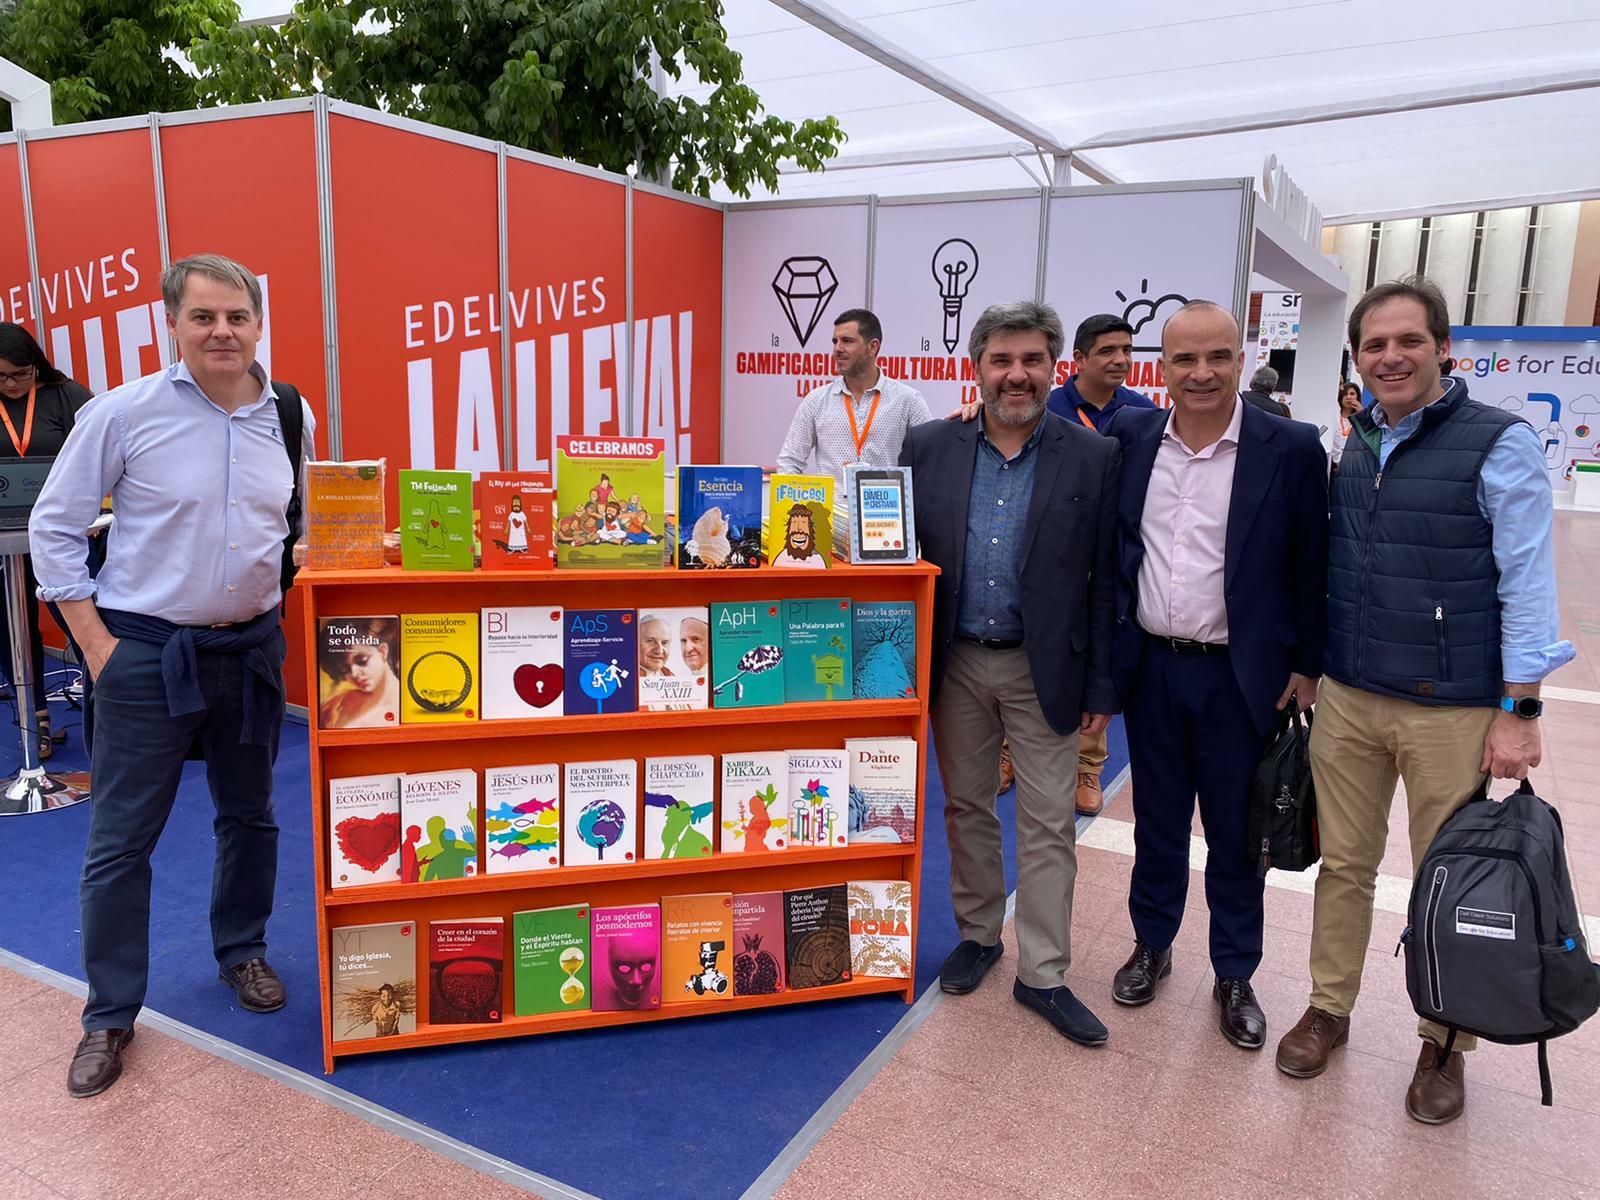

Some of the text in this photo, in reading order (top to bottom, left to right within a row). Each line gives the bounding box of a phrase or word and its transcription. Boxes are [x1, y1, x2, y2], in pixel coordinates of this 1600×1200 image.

[405, 276, 606, 349] EDELVIVES
[772, 334, 779, 346] la
[921, 337, 930, 351] la
[877, 356, 957, 380] CULTURA
[1450, 352, 1510, 378] ogle
[1517, 355, 1554, 373] for
[570, 440, 654, 455] CELEBRAMOS
[698, 480, 743, 492] Esencia
[789, 602, 811, 620] PT
[405, 618, 466, 626] Consumidores
[488, 612, 507, 633] BI
[719, 606, 756, 629] ApH
[328, 625, 356, 635] Todo
[405, 626, 456, 634] consumidos
[570, 615, 608, 635] ApS
[344, 636, 380, 645] olvida
[642, 679, 658, 688] San
[661, 688, 692, 698] XXIII
[860, 752, 899, 763] Dante
[650, 762, 697, 772] EL DISEÑO
[789, 760, 842, 768] SIGLO XXI
[650, 770, 704, 779] CHAPUCERO
[726, 766, 770, 777] PIKAZA
[405, 780, 461, 793] JÓVENES
[492, 774, 555, 787] JESÚS HOY
[596, 911, 651, 922] Los apócrifos
[596, 920, 652, 932] posmodernos
[851, 920, 910, 936] ROMA
[338, 930, 368, 952] YT
[521, 936, 541, 944] Donde
[349, 954, 364, 962] digo
[366, 952, 392, 961] Iglesia,
